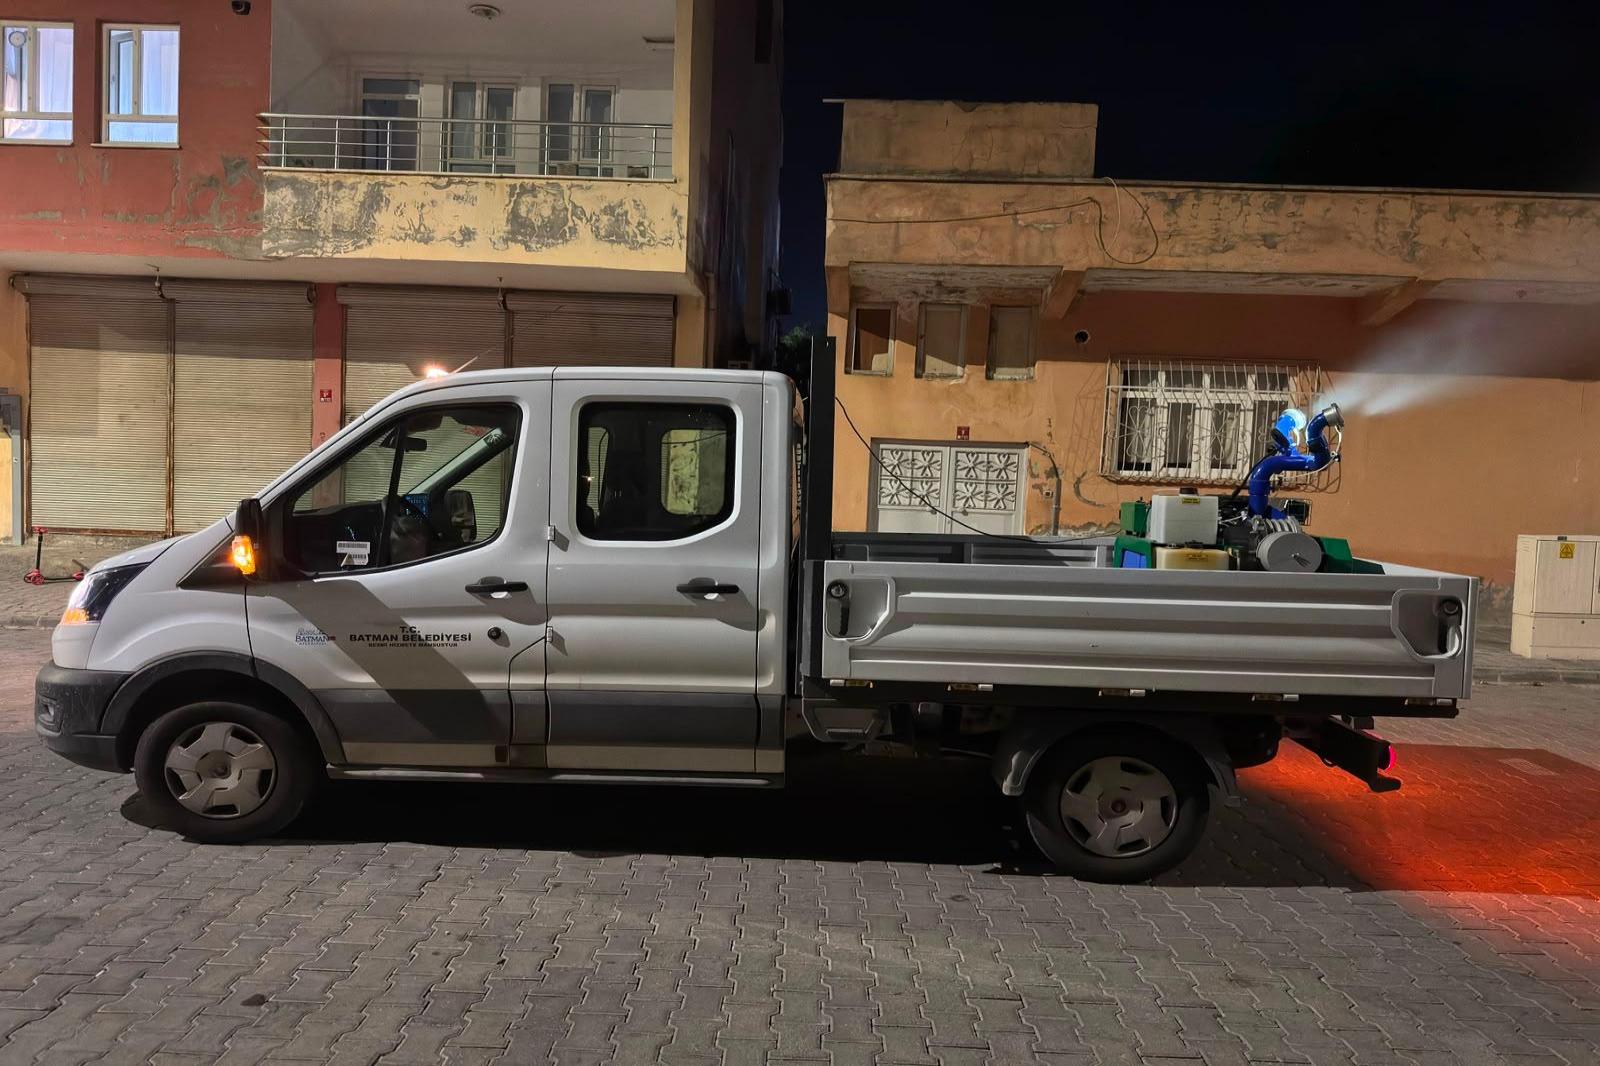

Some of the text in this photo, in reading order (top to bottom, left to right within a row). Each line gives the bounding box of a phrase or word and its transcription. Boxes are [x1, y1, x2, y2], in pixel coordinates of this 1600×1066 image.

[400, 626, 420, 634] T.C.
[349, 632, 472, 642] BATMAN BELEDİYESİ
